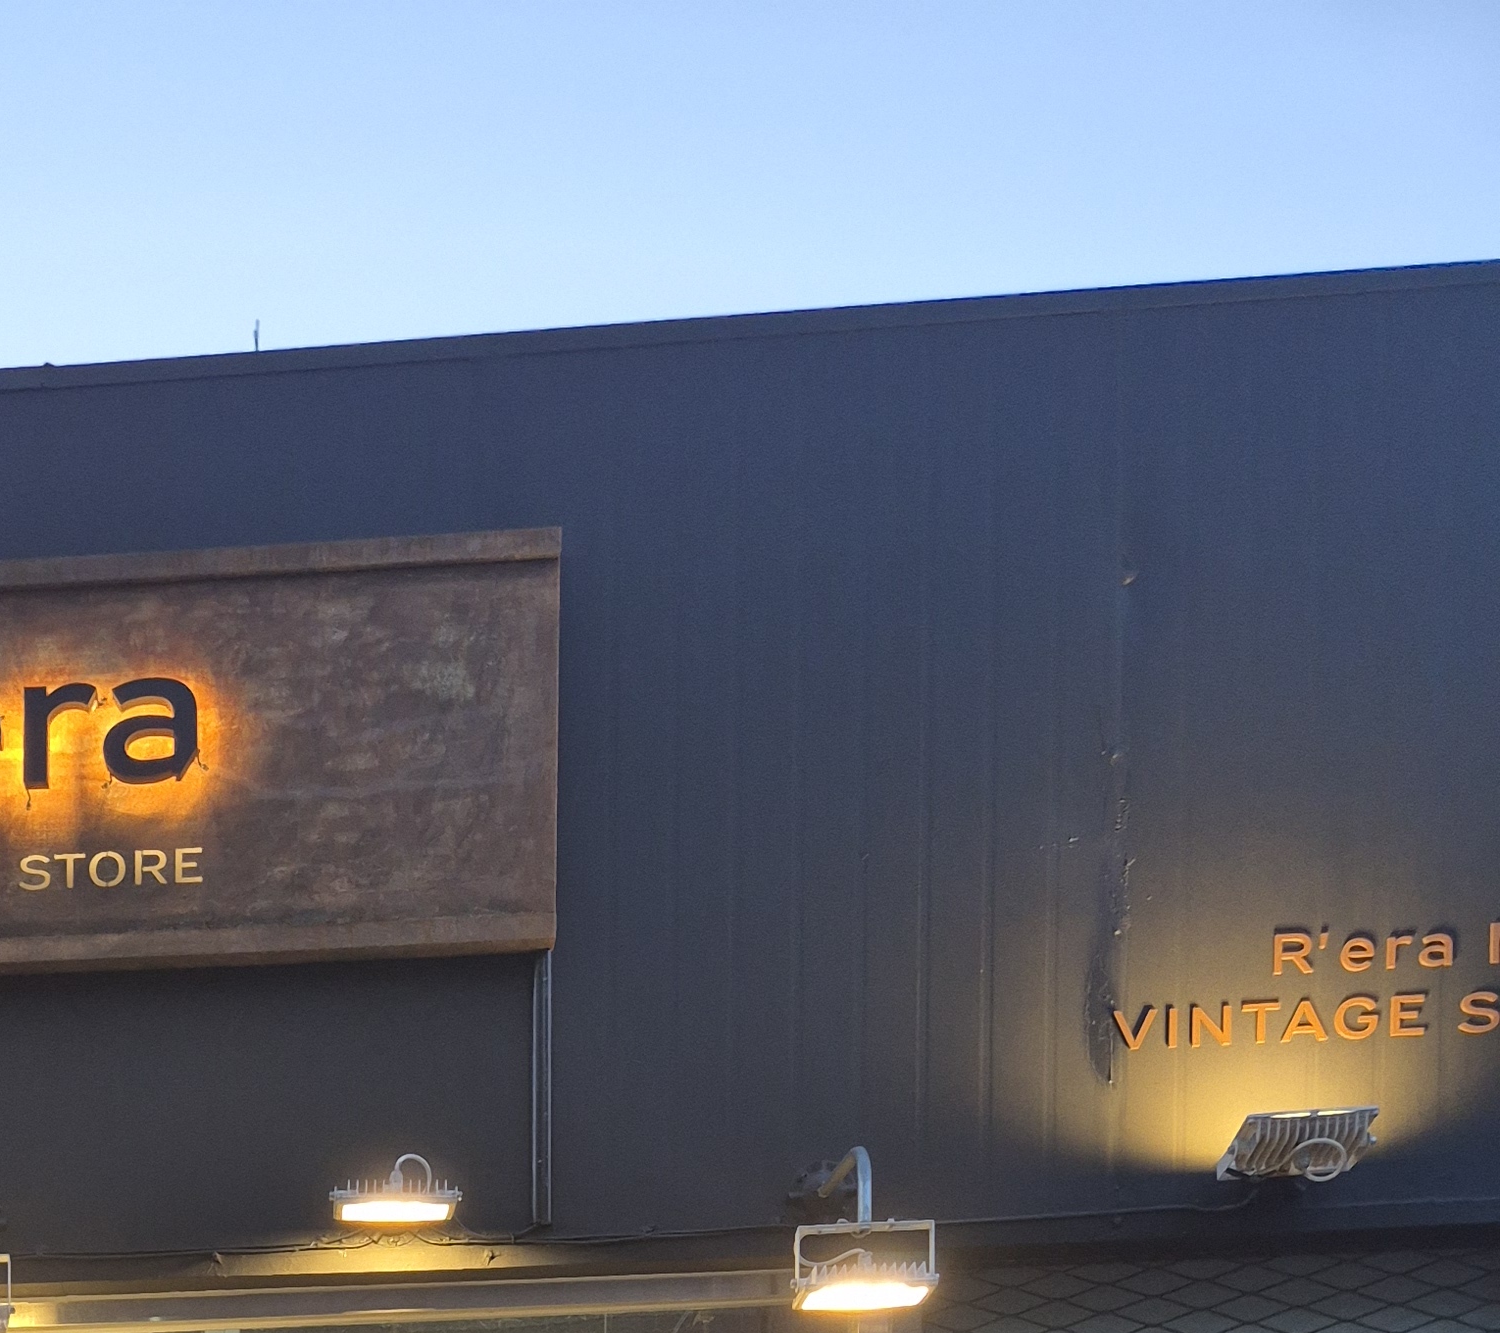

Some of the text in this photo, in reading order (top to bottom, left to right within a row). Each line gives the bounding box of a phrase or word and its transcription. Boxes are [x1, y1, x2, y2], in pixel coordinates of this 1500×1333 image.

[19, 847, 204, 891] STORE
[1273, 931, 1454, 976] R'era
[1113, 994, 1426, 1050] VINTAGE
